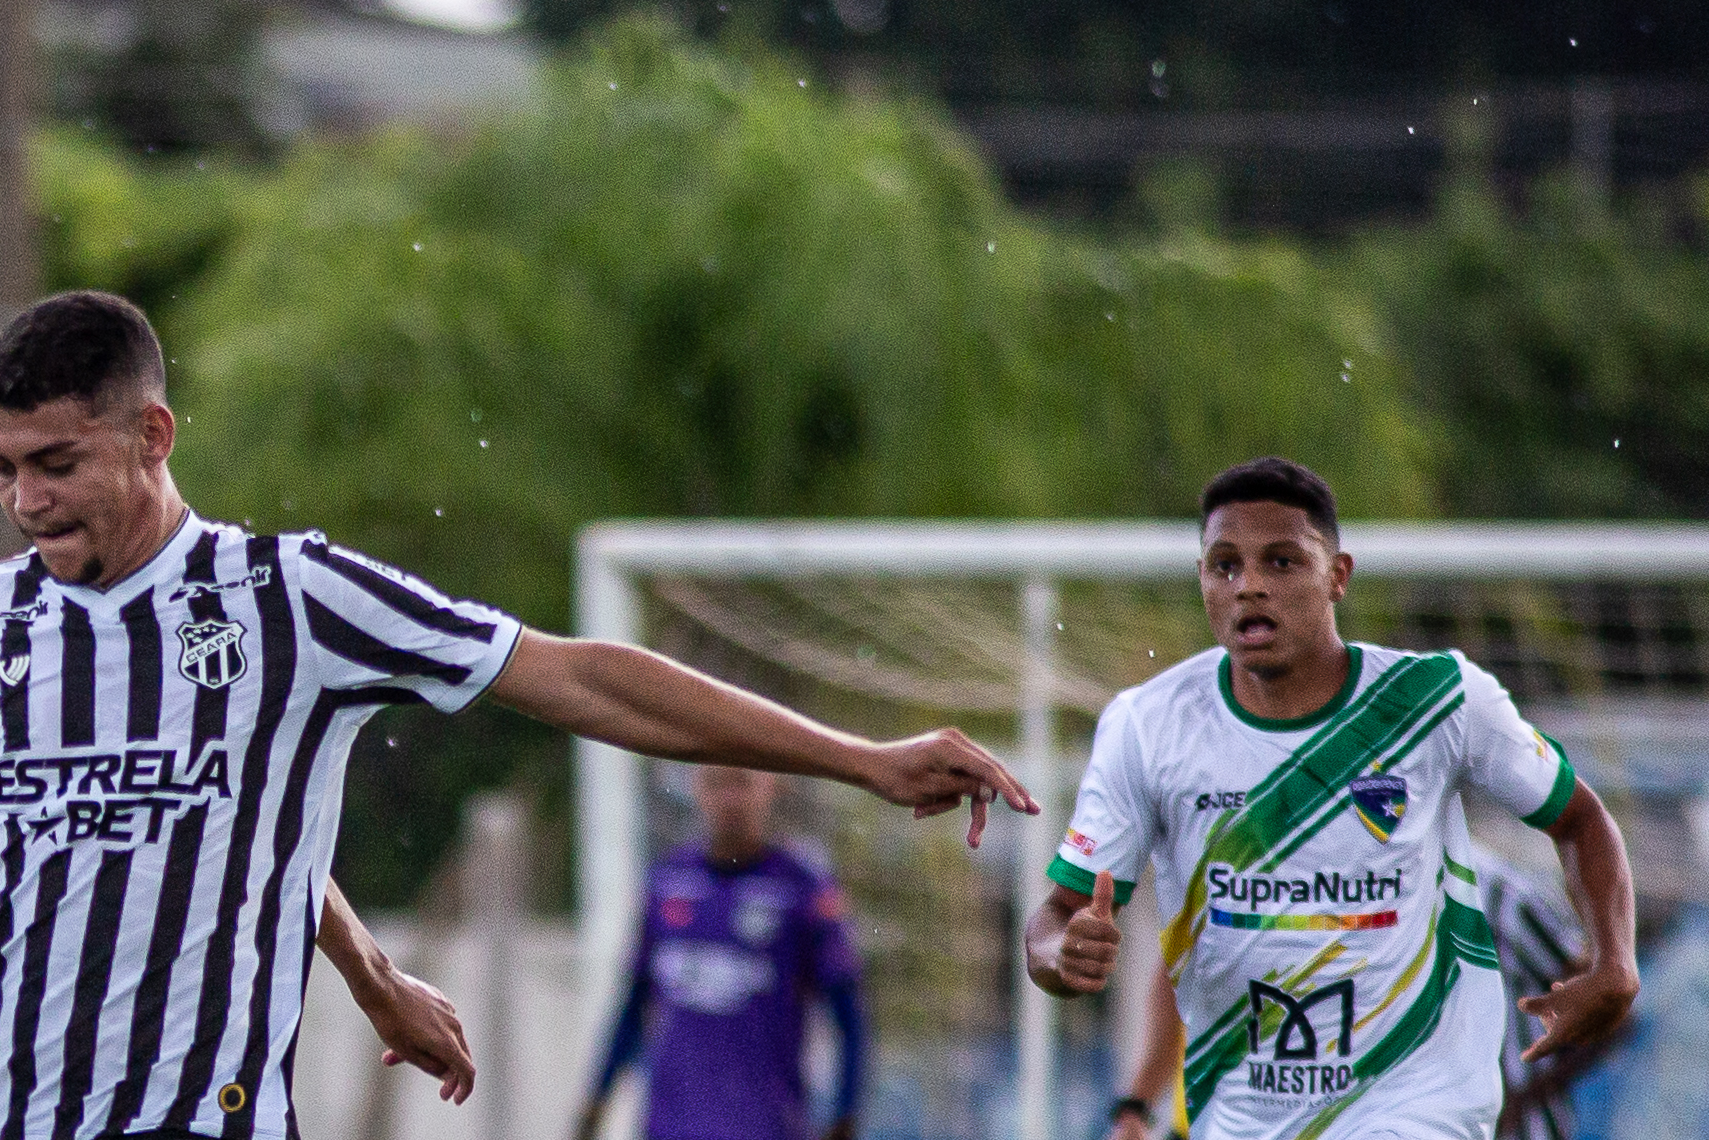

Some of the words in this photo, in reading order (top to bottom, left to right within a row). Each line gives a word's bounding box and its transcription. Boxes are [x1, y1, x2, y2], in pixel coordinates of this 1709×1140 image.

[66, 798, 183, 844] BET
[1208, 867, 1403, 912] SupraNutri
[1248, 1061, 1352, 1095] MAESTRO
